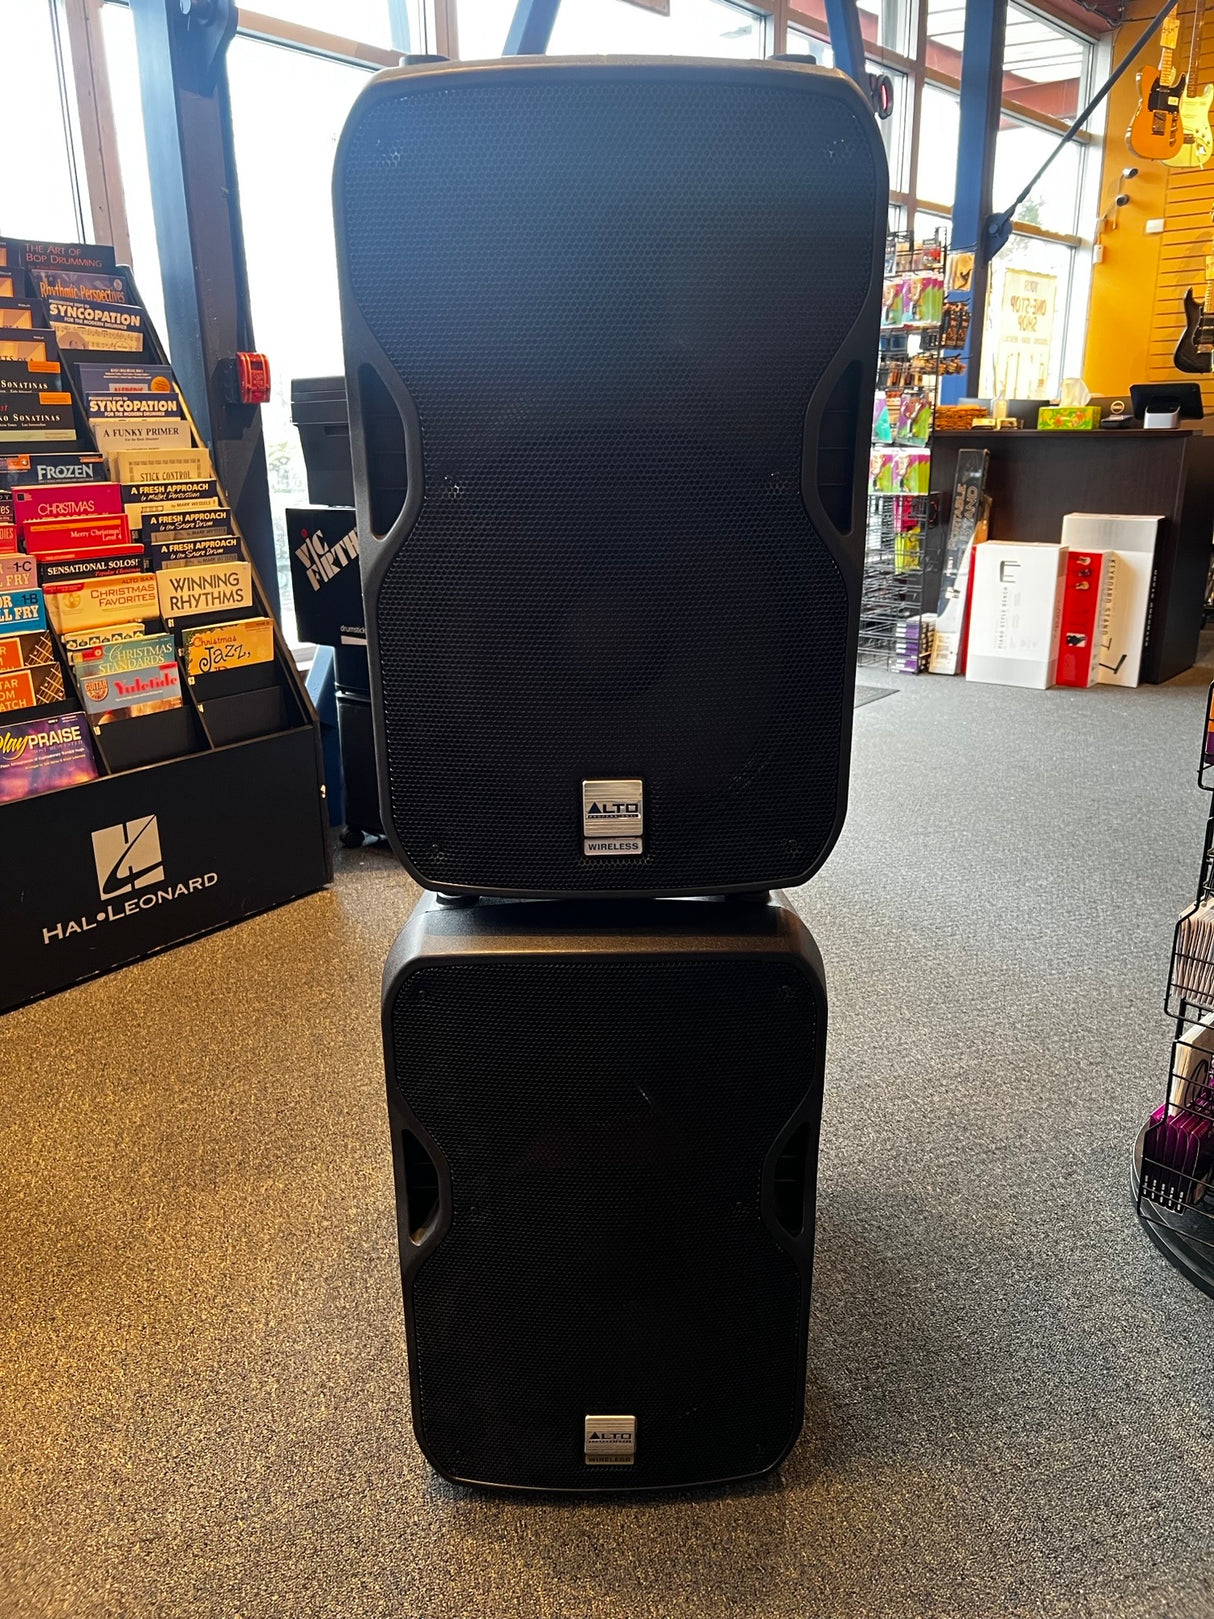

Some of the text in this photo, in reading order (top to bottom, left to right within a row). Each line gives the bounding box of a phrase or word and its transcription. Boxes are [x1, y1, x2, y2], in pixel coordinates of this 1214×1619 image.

[25, 243, 81, 256] THE ART OF
[26, 253, 47, 262] BOP
[50, 255, 102, 268] DRUMMING
[40, 278, 126, 303] Rhythmic Perspectives
[49, 303, 140, 327] SYNCOPATION
[0, 379, 48, 389] SONATINAS
[89, 400, 177, 412] SYNCOPATION
[12, 413, 61, 422] SONATINAS
[103, 427, 180, 438] A FUNKY PRIMER
[37, 463, 94, 480] FROZEN
[140, 470, 192, 482] STICK CONTROL
[130, 483, 209, 495] A FRESH APPROACH
[38, 500, 95, 516] CHRISTMAS
[150, 512, 227, 525] A FRESH APPROACH
[70, 530, 89, 538] Merry
[161, 539, 237, 553] A FRESH APPROACH
[294, 527, 329, 570] VIC
[13, 560, 32, 572] 1-C
[47, 558, 139, 576] SENSATIONAL SOLOS!
[6, 572, 30, 587] FRY
[121, 577, 139, 585] ALTO
[169, 572, 240, 593] WINNING
[90, 584, 155, 599] CHRISTMAS
[21, 593, 39, 605] 1-B
[98, 593, 156, 607] FAVORITES
[170, 588, 244, 611] RHYTHMS
[13, 604, 39, 620] FRY
[192, 635, 238, 648] Christmas
[109, 643, 173, 662] CHRISTMAS
[98, 654, 165, 674] STANDARDS
[113, 672, 178, 695] Yuletide
[28, 725, 82, 750] PRAISE
[588, 801, 639, 814] ALTO
[588, 842, 639, 851] WIRELESS
[589, 1431, 632, 1440] ALTO
